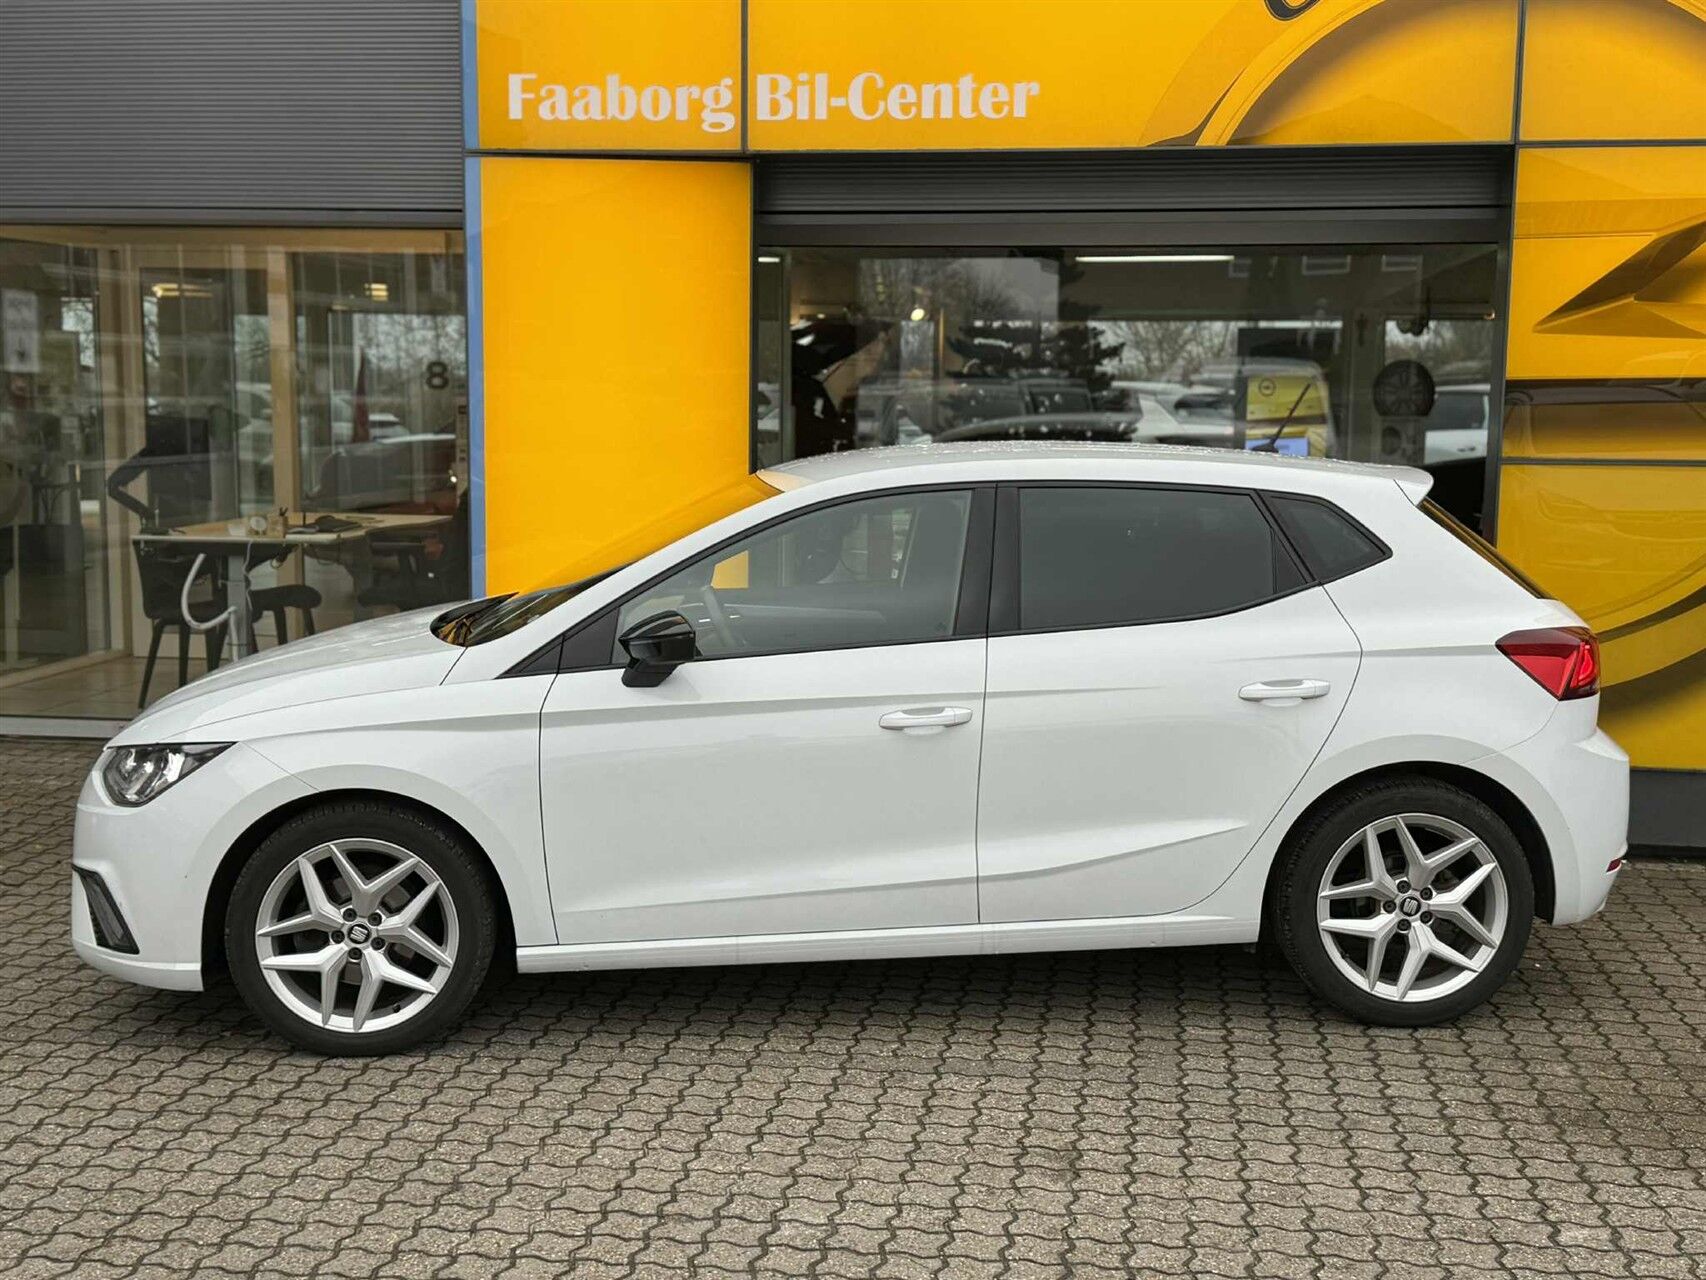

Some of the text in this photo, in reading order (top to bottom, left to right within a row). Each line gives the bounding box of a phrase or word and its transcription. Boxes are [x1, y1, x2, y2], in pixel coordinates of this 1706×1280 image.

[508, 72, 1040, 133] Faaborg Bil-Center
[426, 361, 448, 390] 8
